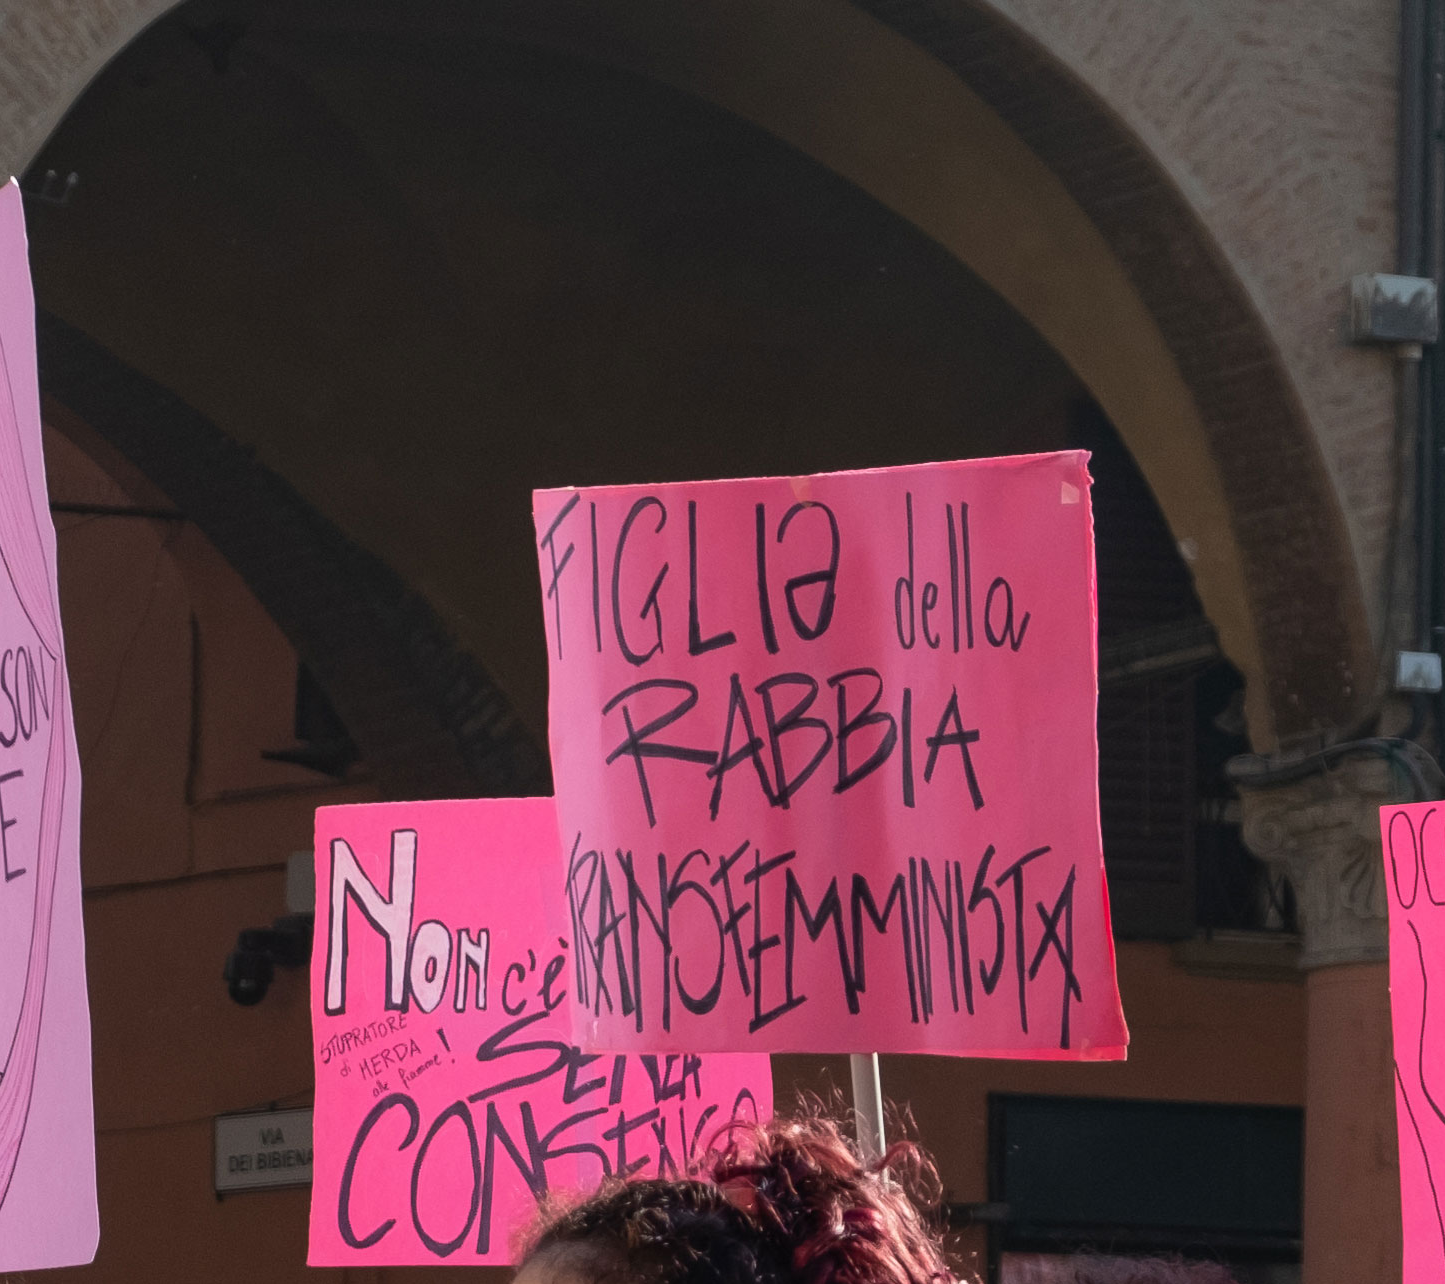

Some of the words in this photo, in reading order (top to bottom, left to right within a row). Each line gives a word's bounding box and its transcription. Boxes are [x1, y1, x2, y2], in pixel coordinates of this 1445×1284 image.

[894, 493, 1031, 655] della
[601, 668, 985, 827] RABBIA
[321, 1013, 407, 1064] STUPRATORE
[340, 1060, 351, 1077] di
[359, 1038, 421, 1080] MERDA
[259, 1127, 285, 1146] VIA
[229, 1154, 252, 1172] DEI
